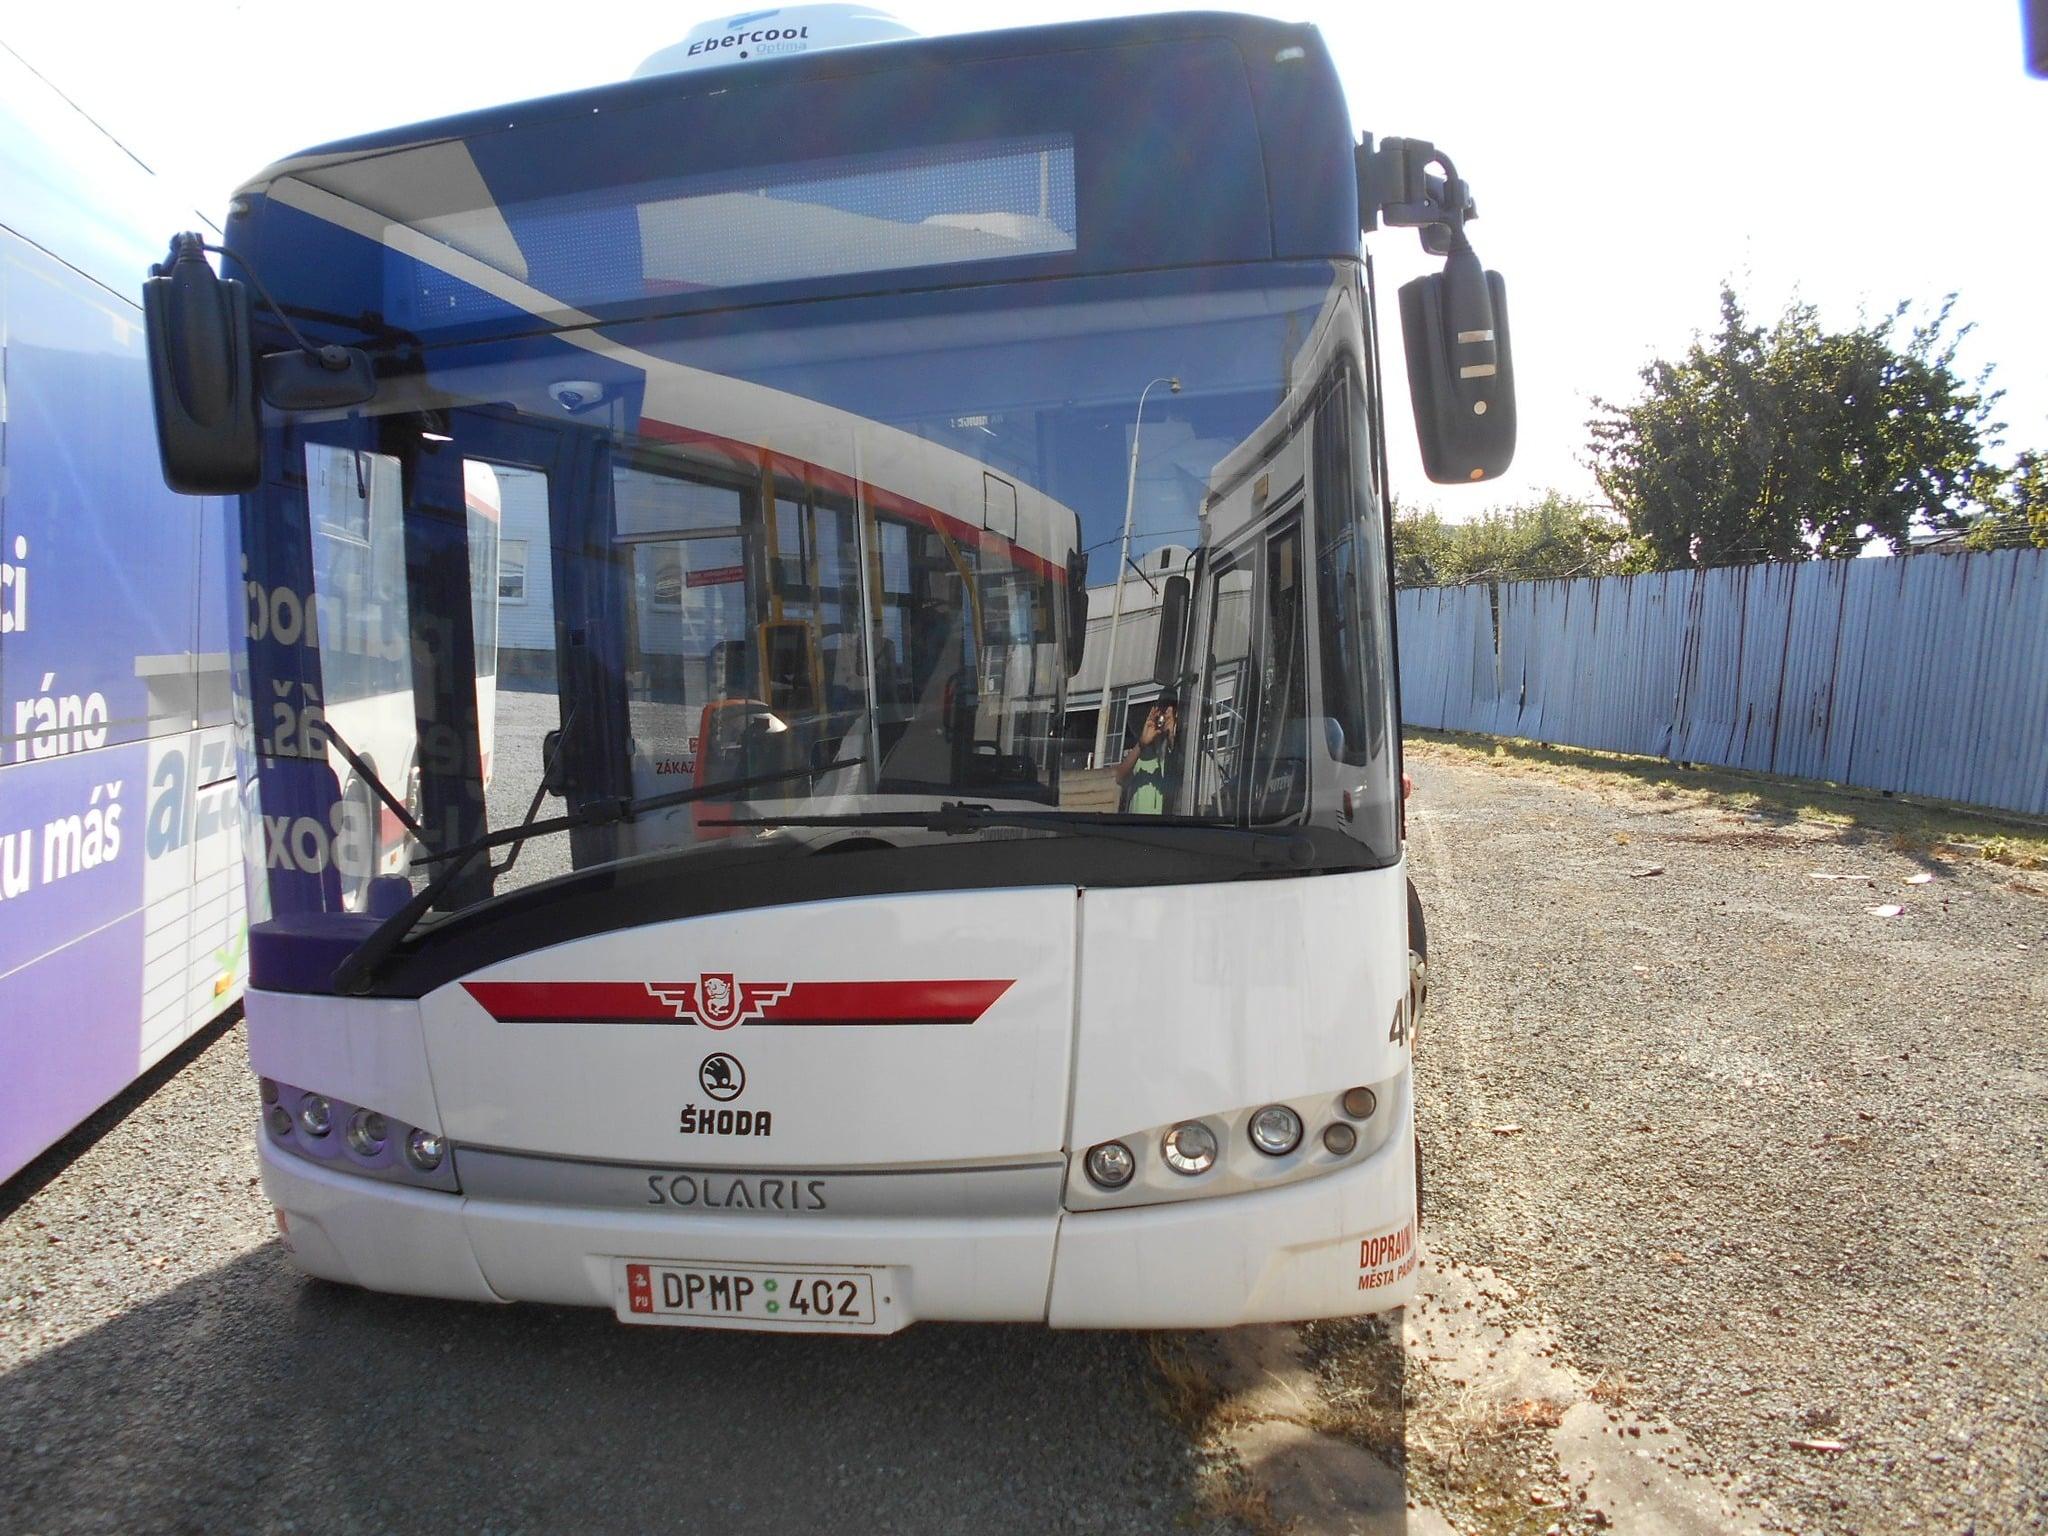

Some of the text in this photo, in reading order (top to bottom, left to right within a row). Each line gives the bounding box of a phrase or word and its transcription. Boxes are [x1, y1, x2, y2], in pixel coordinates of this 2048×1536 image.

[688, 26, 808, 56] Ebercool
[15, 672, 107, 762] ráno
[42, 780, 122, 884] máš
[680, 1104, 771, 1136] ŠKODA
[648, 1175, 826, 1210] SOLARIS
[663, 1272, 859, 1317] DPMP 402
[1358, 1269, 1394, 1290] MĚSTA
